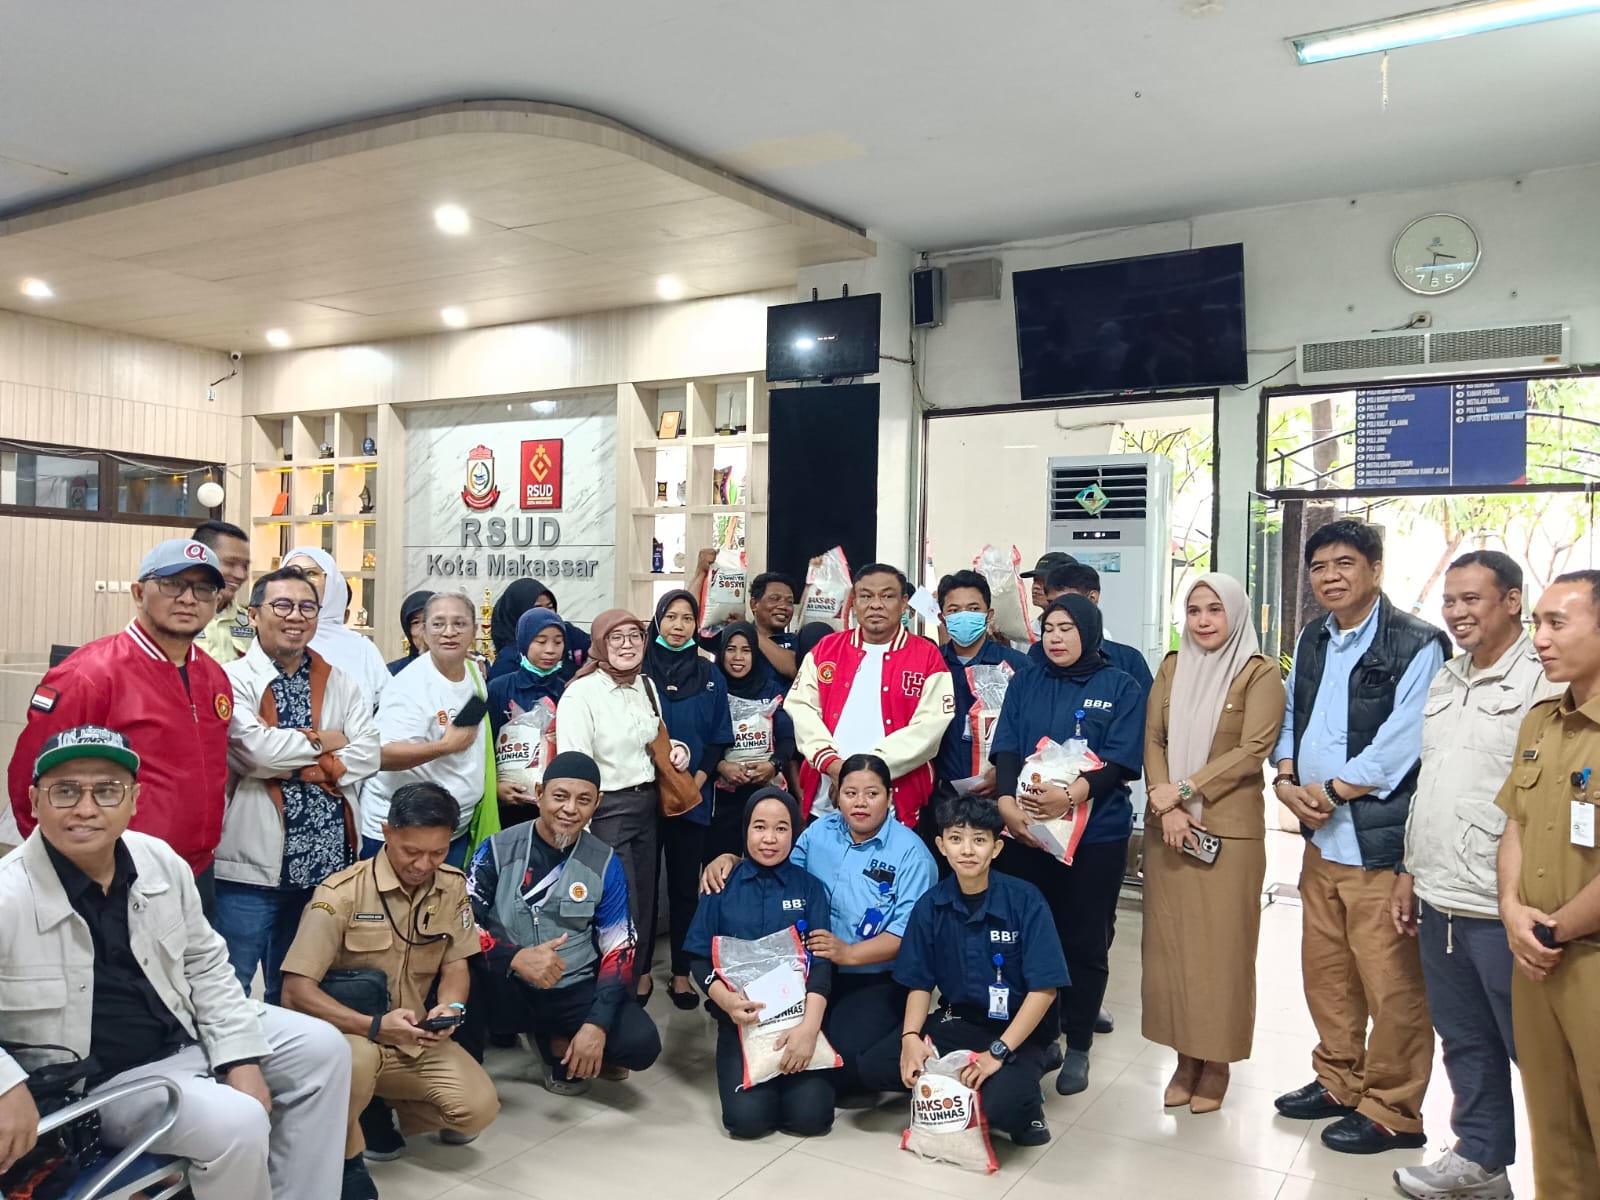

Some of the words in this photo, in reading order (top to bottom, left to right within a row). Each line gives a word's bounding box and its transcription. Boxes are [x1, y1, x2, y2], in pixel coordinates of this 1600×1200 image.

[1444, 273, 1454, 283] 5
[1435, 466, 1450, 474] JALAN
[527, 484, 553, 497] RSUD
[461, 516, 561, 549] RSUD
[427, 554, 477, 577] Kota
[487, 554, 598, 578] Makassar
[1083, 698, 1112, 709] BBP
[736, 731, 766, 741] AKSOS
[497, 742, 530, 754] AKSOS
[742, 740, 767, 748] UNHAS
[502, 752, 529, 760] UNHAS
[990, 930, 1018, 942] BBP
[774, 1004, 802, 1018] NHAS
[916, 1096, 962, 1112] BAKSOS
[930, 1108, 965, 1121] UNHAS
